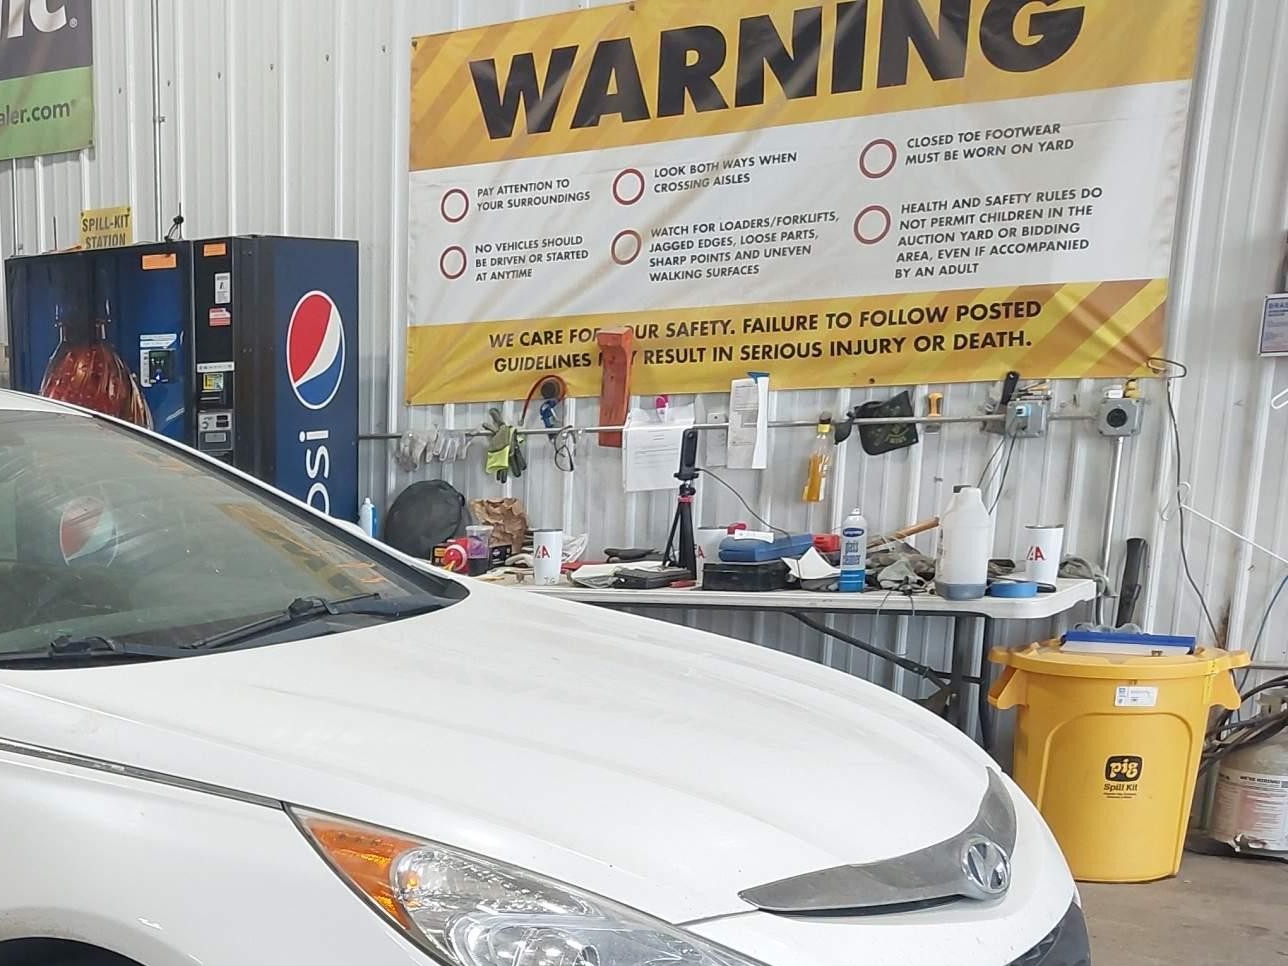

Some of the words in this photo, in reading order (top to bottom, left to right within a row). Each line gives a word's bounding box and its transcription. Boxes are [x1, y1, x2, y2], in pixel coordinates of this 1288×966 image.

[469, 0, 1086, 141] WARNING
[907, 135, 953, 148] CLOSED
[958, 131, 981, 144] TOE
[985, 124, 1061, 141] FOOTWEAR
[905, 153, 940, 165] MUST
[944, 151, 959, 161] BE
[963, 145, 1006, 159] WORN
[1011, 143, 1033, 154] ON
[1039, 139, 1074, 151] YARD
[654, 166, 686, 178] LOOK
[690, 162, 719, 174] BOTH
[722, 157, 755, 169] WAYS
[759, 152, 797, 165] WHEN
[477, 187, 494, 197] PAY
[497, 181, 552, 195] ATTENTION
[556, 179, 569, 188] TO
[654, 178, 710, 193] CROSSING
[713, 173, 750, 186] AISLES
[477, 201, 503, 211] YOUR
[507, 191, 590, 208] SURROUNDINGS
[901, 200, 947, 214] HEALTH
[952, 197, 980, 209] AND
[985, 193, 1031, 206] SAFETY
[1036, 189, 1076, 202] RULES
[1081, 187, 1102, 198] DO
[82, 214, 129, 232] SPILL-KIT
[651, 226, 688, 238] WATCH
[693, 223, 715, 233] FOR
[720, 211, 840, 231] LOADERS/FORKLIFTS,
[900, 219, 927, 230] NOT
[931, 214, 975, 227] PERMIT
[980, 208, 1043, 223] CHILDREN
[1048, 208, 1063, 218] IN
[1069, 205, 1093, 216] THE
[86, 233, 125, 249] STATION
[475, 244, 492, 253] NO
[495, 240, 538, 251] VEHICLES
[542, 236, 583, 247] SHOULD
[650, 240, 694, 252] JAGGED
[698, 237, 737, 248] EDGES,
[740, 233, 776, 245] LOOSE
[781, 229, 818, 241] PARTS,
[898, 232, 955, 246] AUCTION
[961, 229, 993, 241] YARD
[998, 228, 1017, 238] OR
[1022, 223, 1080, 236] BIDDING
[476, 259, 487, 267] BE
[490, 256, 526, 266] DRIVEN
[529, 254, 543, 263] OR
[546, 250, 588, 261] STARTED
[650, 255, 686, 267] SHARP
[690, 252, 731, 264] POINTS
[735, 249, 760, 260] AND
[764, 245, 811, 258] UNEVEN
[896, 251, 932, 263] AREA,
[938, 248, 970, 259] EVEN
[975, 246, 986, 256] IF
[990, 239, 1089, 255] ACCOMPANIED
[476, 273, 487, 281] AT
[490, 269, 532, 280] ANYTIME
[650, 269, 702, 282] WALKING
[707, 265, 759, 278] SURFACES
[895, 268, 911, 278] BY
[915, 266, 934, 277] AN
[939, 263, 978, 275] ADULT
[490, 333, 514, 348] WE
[520, 330, 563, 346] CARE
[666, 319, 735, 337] SAFETY.
[743, 314, 818, 333] FAILURE
[826, 312, 852, 329] TO
[860, 306, 949, 327] FOLLOW
[956, 301, 1042, 322] POSTED
[494, 352, 592, 372] GUIDELINES
[644, 348, 706, 364] RESULT
[713, 346, 733, 362] IN
[740, 342, 822, 360] SERIOUS
[830, 337, 906, 356] INJURY
[914, 335, 945, 352] OR
[953, 330, 1032, 350] DEATH.
[1109, 759, 1138, 778] pig
[1103, 783, 1124, 791] Spill
